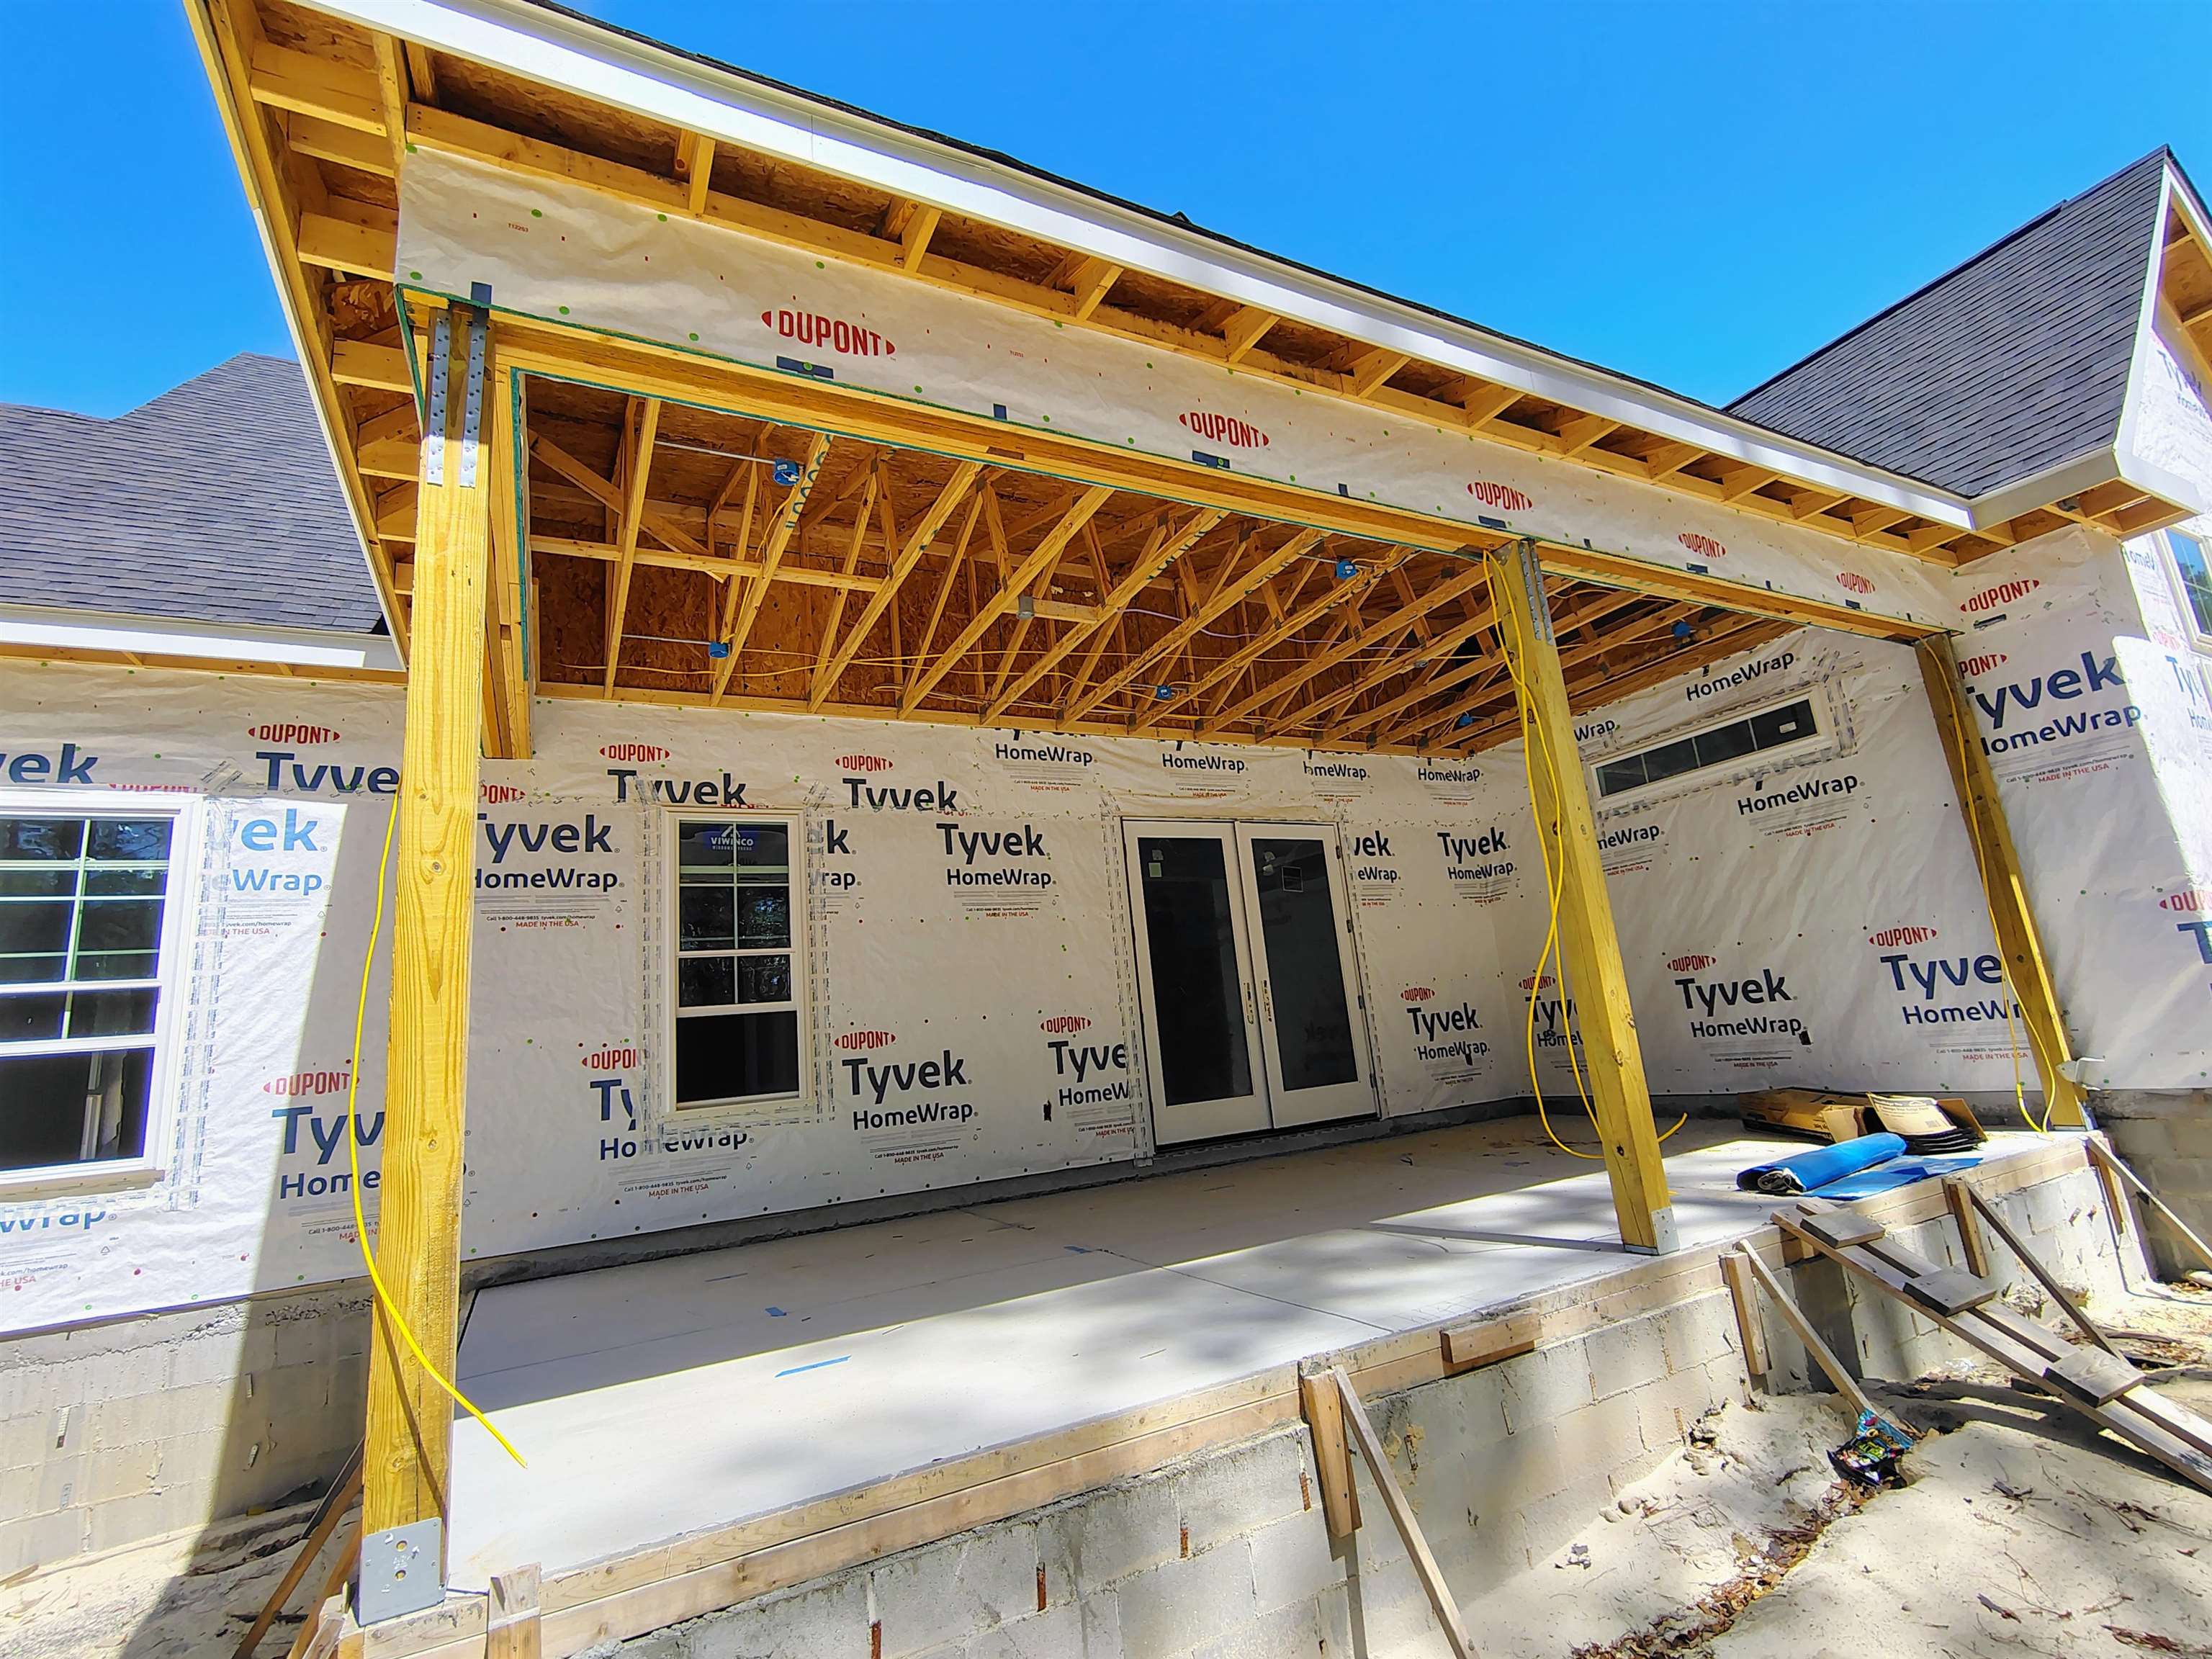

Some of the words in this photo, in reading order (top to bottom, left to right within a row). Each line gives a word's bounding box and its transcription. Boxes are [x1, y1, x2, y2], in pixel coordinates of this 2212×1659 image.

[778, 310, 882, 357] DUPONT
[1190, 411, 1260, 448] DUPONT
[1475, 482, 1526, 511] DUPONT
[1683, 532, 1722, 558] DUPONT
[1841, 572, 1872, 594] DUPONT
[1969, 580, 2030, 612] DUPONT
[1686, 652, 1794, 701] HomeWrap
[1966, 651, 2126, 729] yvek
[260, 724, 331, 744] DUPONT
[1574, 719, 1615, 742] Wrap
[0, 743, 99, 784] ek
[608, 745, 663, 762] DUPONT
[842, 755, 887, 772] DUPONT
[995, 743, 1093, 766] HomeWrap
[1162, 753, 1244, 774] HomeWrap
[256, 752, 400, 793] Tyve
[1418, 767, 1480, 783] HomeWrap
[2038, 774, 2060, 783] MADE
[1737, 774, 1858, 816] HomeWrap
[230, 808, 318, 852] ek
[477, 813, 613, 864] yvek
[711, 837, 753, 846] VIWINCO
[937, 823, 1045, 865] Tyvek
[1438, 827, 1506, 863] Tyvek
[947, 868, 1051, 891] HomeWrap
[1447, 861, 1514, 880] HomeWrap
[232, 869, 323, 896] Wrap
[1876, 926, 1930, 947] DUPONT
[1673, 955, 1710, 971] DUPONT
[1404, 986, 1432, 1002] DUPONT
[1675, 968, 1791, 1016] Tyvek
[1407, 1003, 1478, 1041] Tyvek
[1525, 995, 1578, 1029] Tyv
[1046, 1016, 1088, 1033] DUPONT
[1691, 1017, 1801, 1038] HomeWrap
[842, 1030, 889, 1049] DUPONT
[1418, 1041, 1488, 1061] HomeWrap
[590, 1048, 637, 1069] DUPO
[276, 1072, 351, 1096] DUPONT
[842, 1050, 966, 1104] Tyvek
[853, 1102, 974, 1130] HomeWrap
[271, 1107, 385, 1165] Tyv
[0, 1278, 11, 1287] HE
[14, 1275, 36, 1285] USA
[1, 1263, 68, 1276] k.com/homewrap
